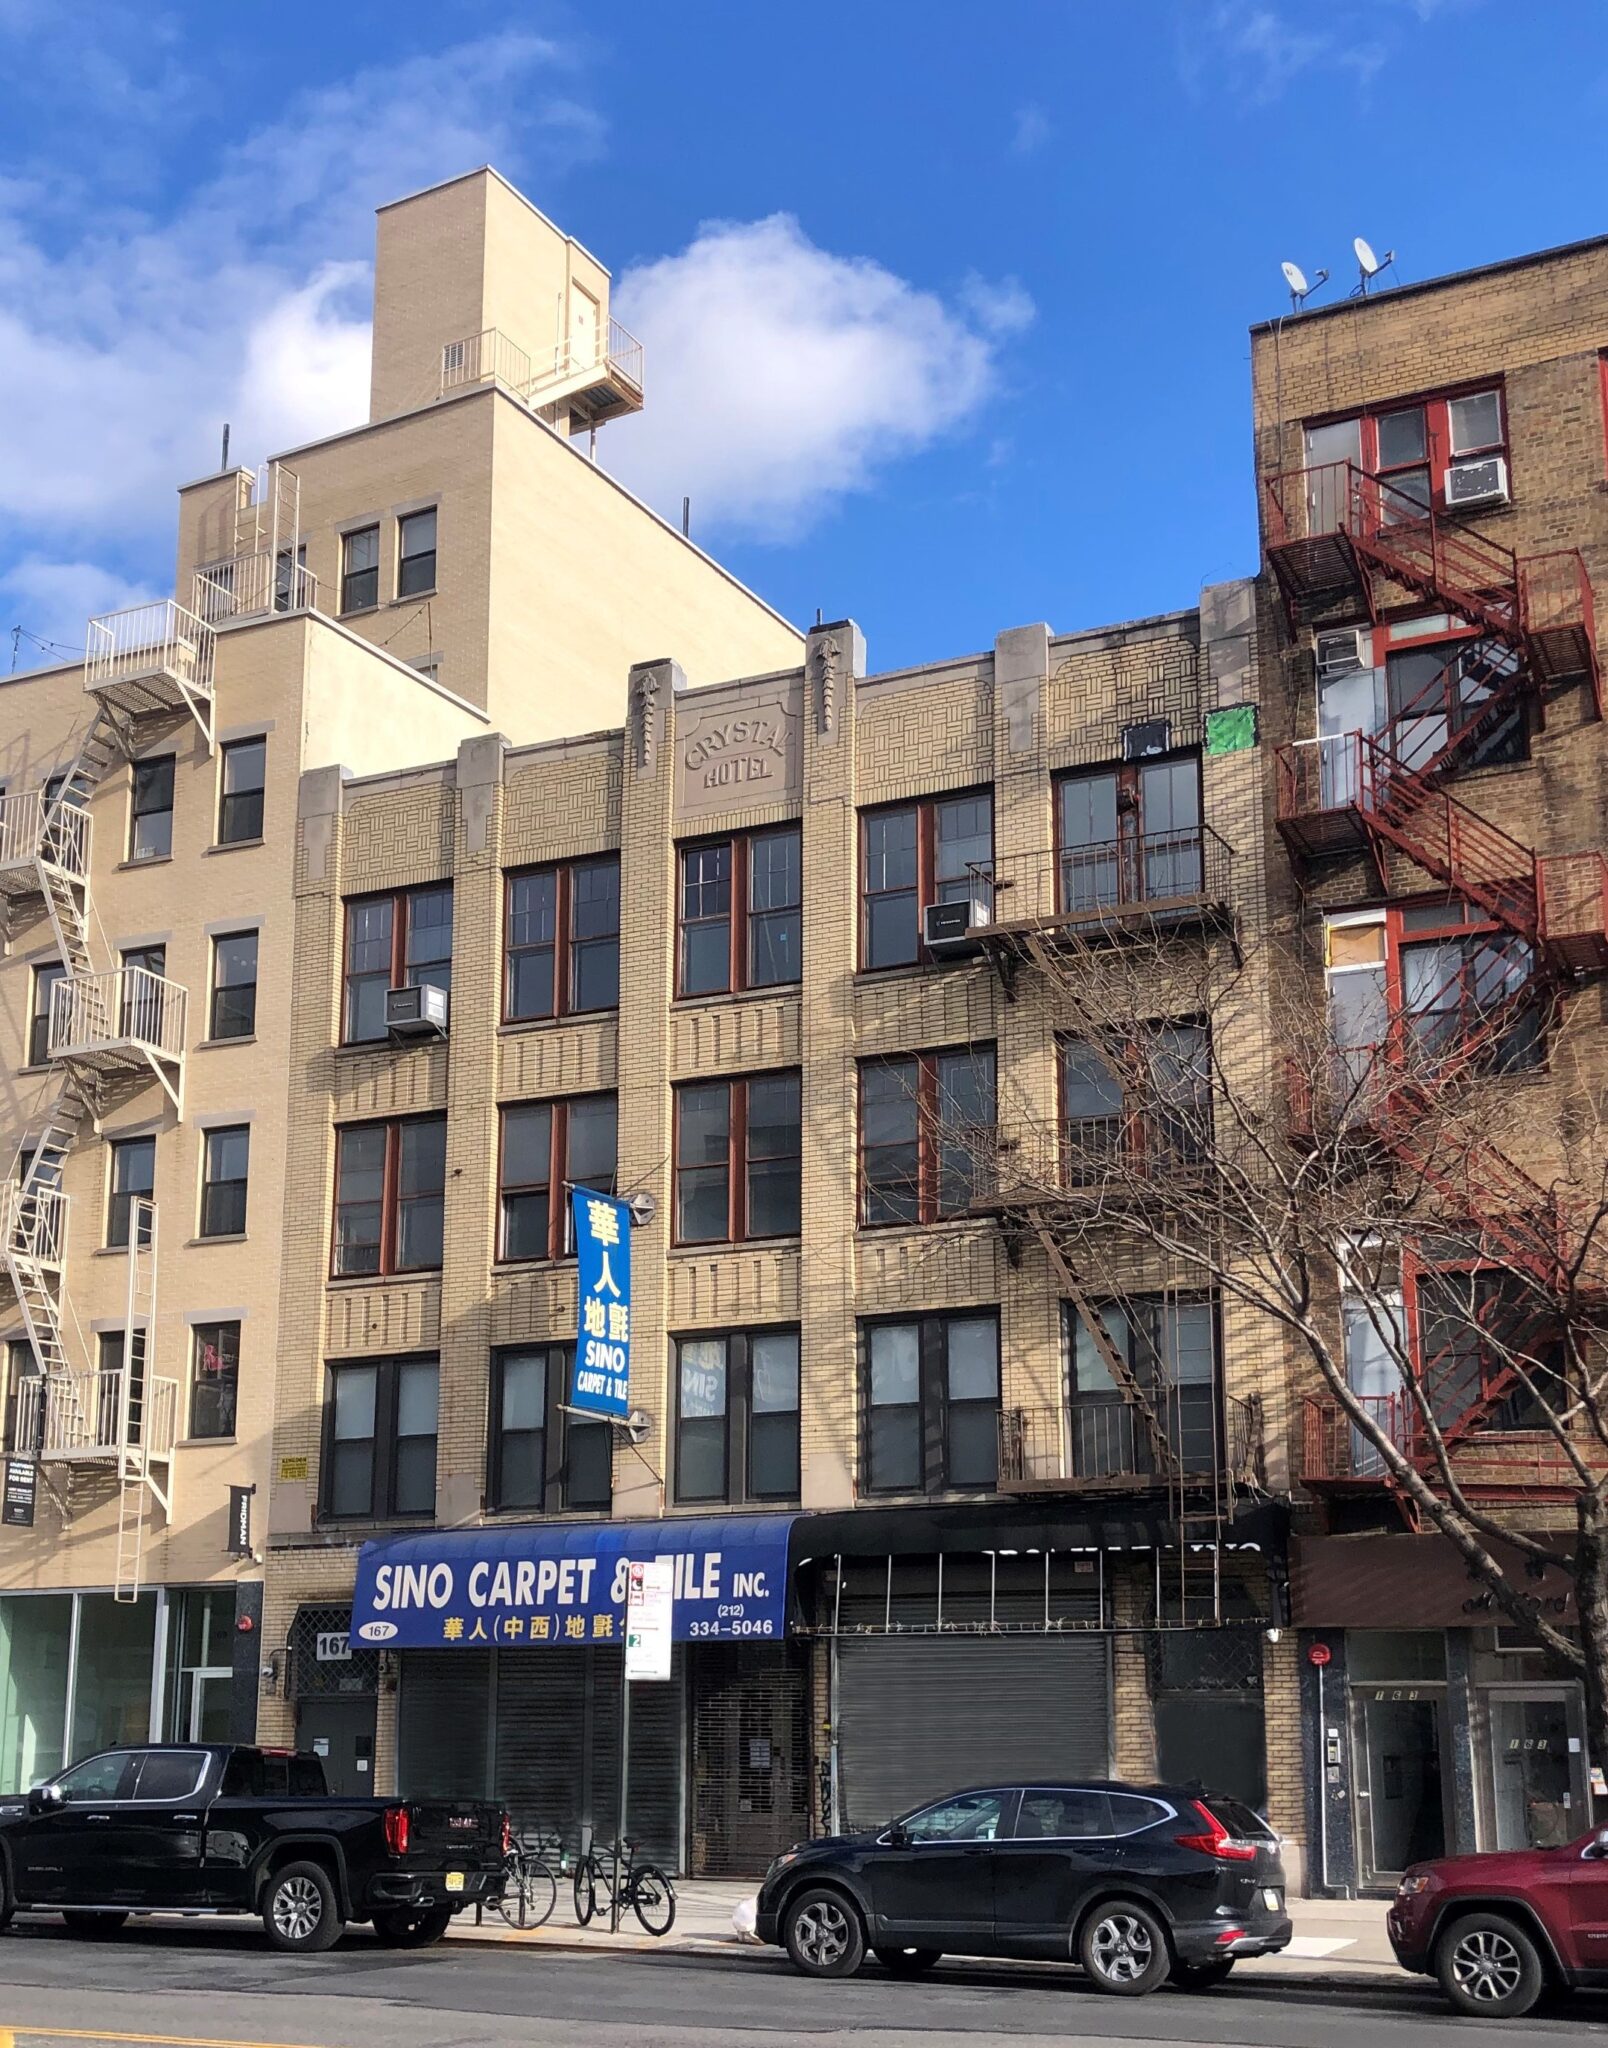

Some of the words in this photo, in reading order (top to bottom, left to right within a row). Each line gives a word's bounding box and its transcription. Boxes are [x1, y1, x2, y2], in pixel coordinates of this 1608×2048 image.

[685, 720, 793, 771] CRYSTAL
[704, 756, 774, 789] HOTEL
[585, 1340, 625, 1373] SINO
[577, 1370, 606, 1395] CARPET
[606, 1377, 613, 1397] &
[614, 1378, 628, 1400] TILE
[240, 1495, 248, 1545] FRIDMAN
[373, 1564, 454, 1611] SINO
[468, 1558, 596, 1608] CARPET
[655, 1552, 722, 1600] ILE
[732, 1572, 769, 1598] INC.
[717, 1603, 745, 1618] (212)
[368, 1625, 390, 1637] 167
[689, 1619, 773, 1637] 334-5046
[319, 1636, 350, 1656] 167
